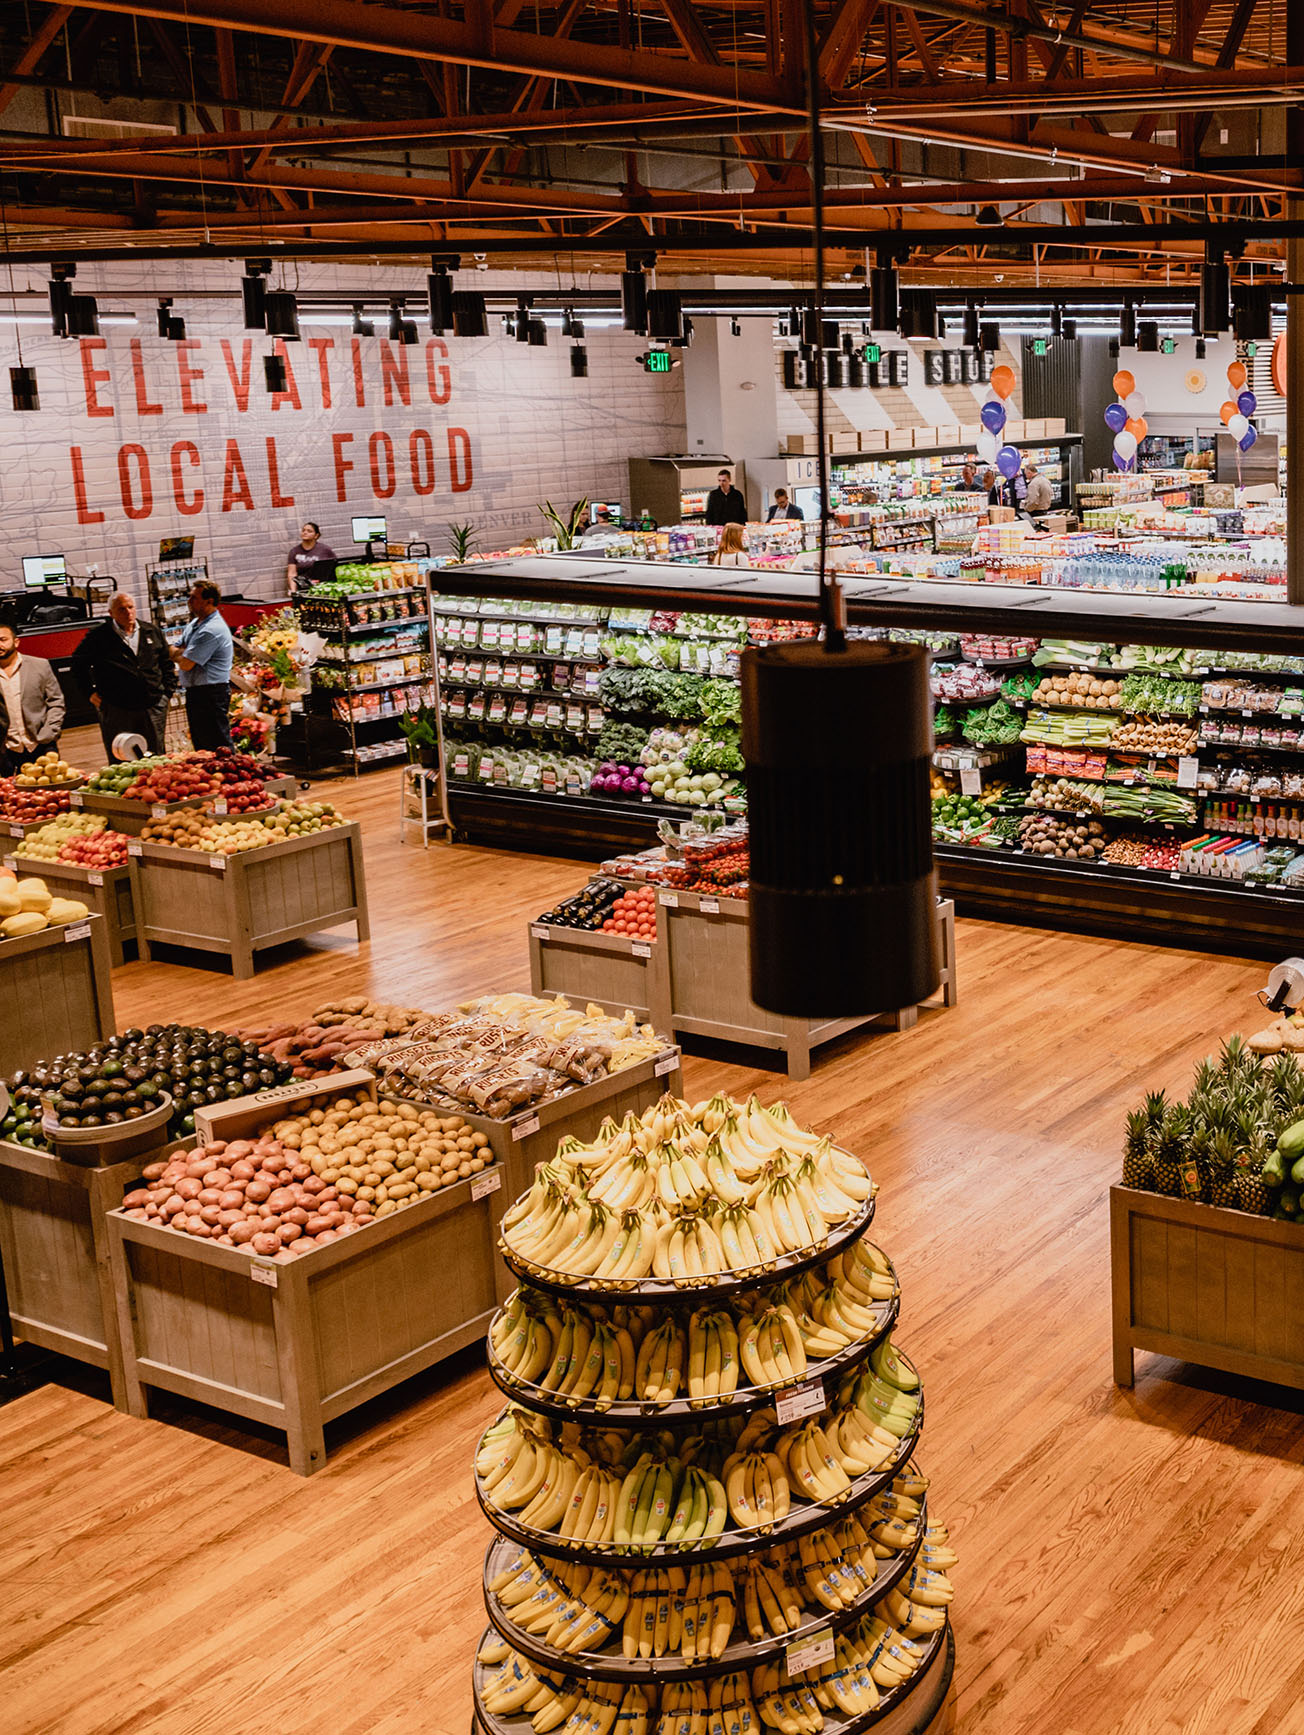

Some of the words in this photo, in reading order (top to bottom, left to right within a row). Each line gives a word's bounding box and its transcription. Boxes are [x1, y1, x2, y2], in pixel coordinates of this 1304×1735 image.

[650, 352, 669, 372] EXIT
[866, 345, 880, 362] EXIT
[78, 337, 453, 418] ELEVATING
[932, 353, 994, 382] SHOP
[70, 435, 295, 525] LOCAL
[332, 427, 474, 503] FOOD
[475, 1067, 520, 1091] RUSSETS
